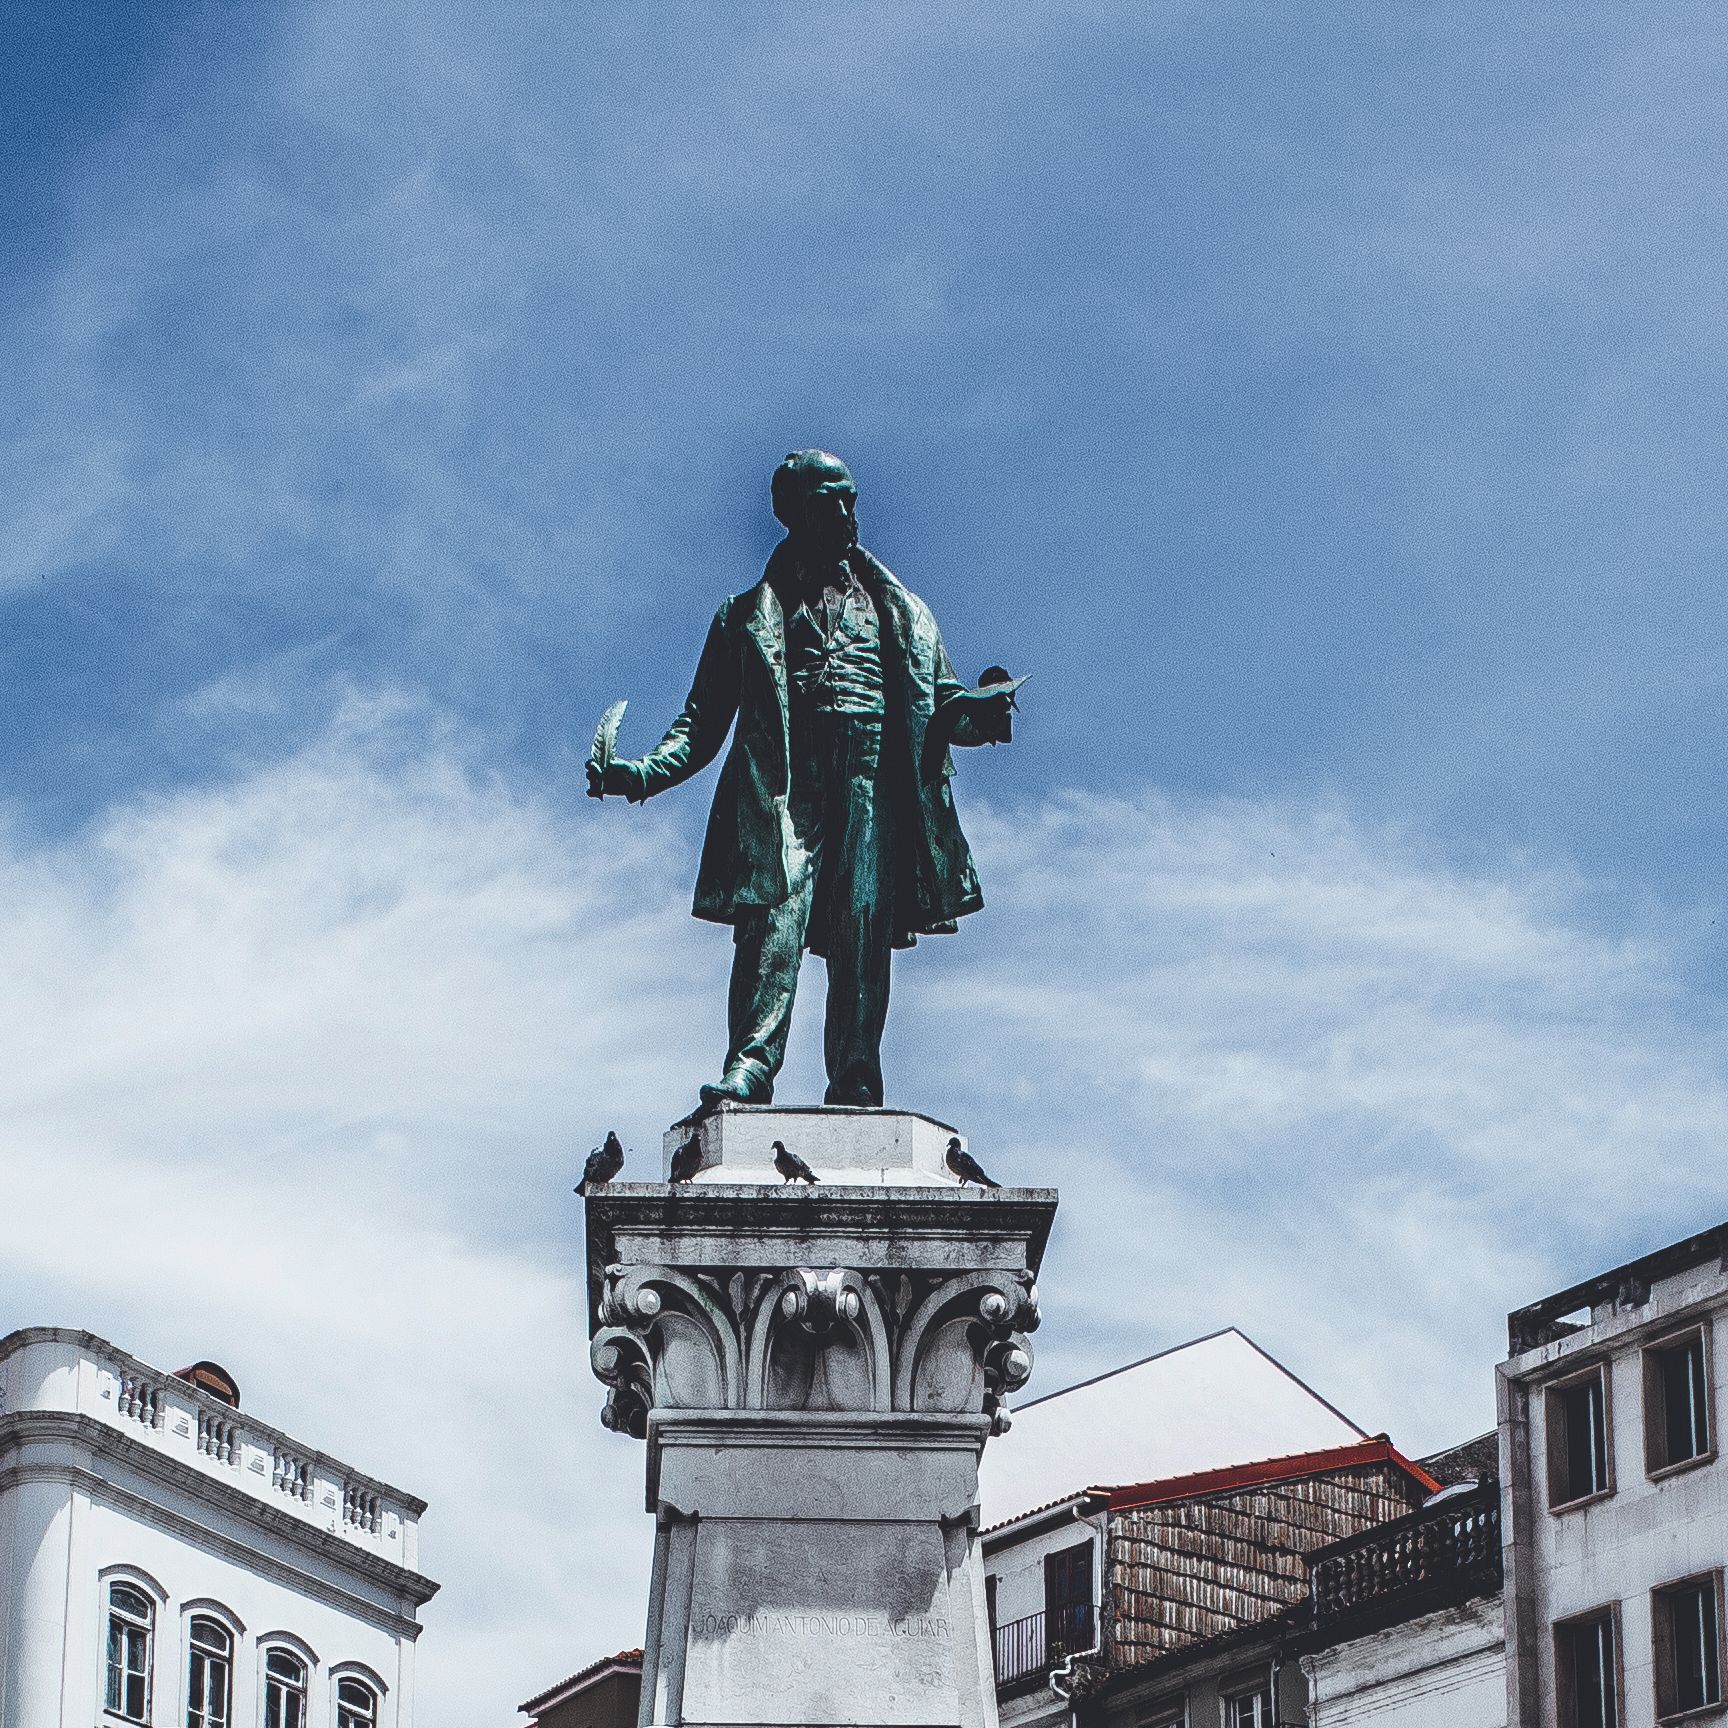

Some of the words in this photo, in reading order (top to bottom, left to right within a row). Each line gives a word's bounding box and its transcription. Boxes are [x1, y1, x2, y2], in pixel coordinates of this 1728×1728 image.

[693, 1613, 769, 1635] JOAQUIM
[773, 1615, 851, 1637] ANTONIO
[855, 1616, 878, 1637] DE
[887, 1617, 950, 1639] AGUIAR
